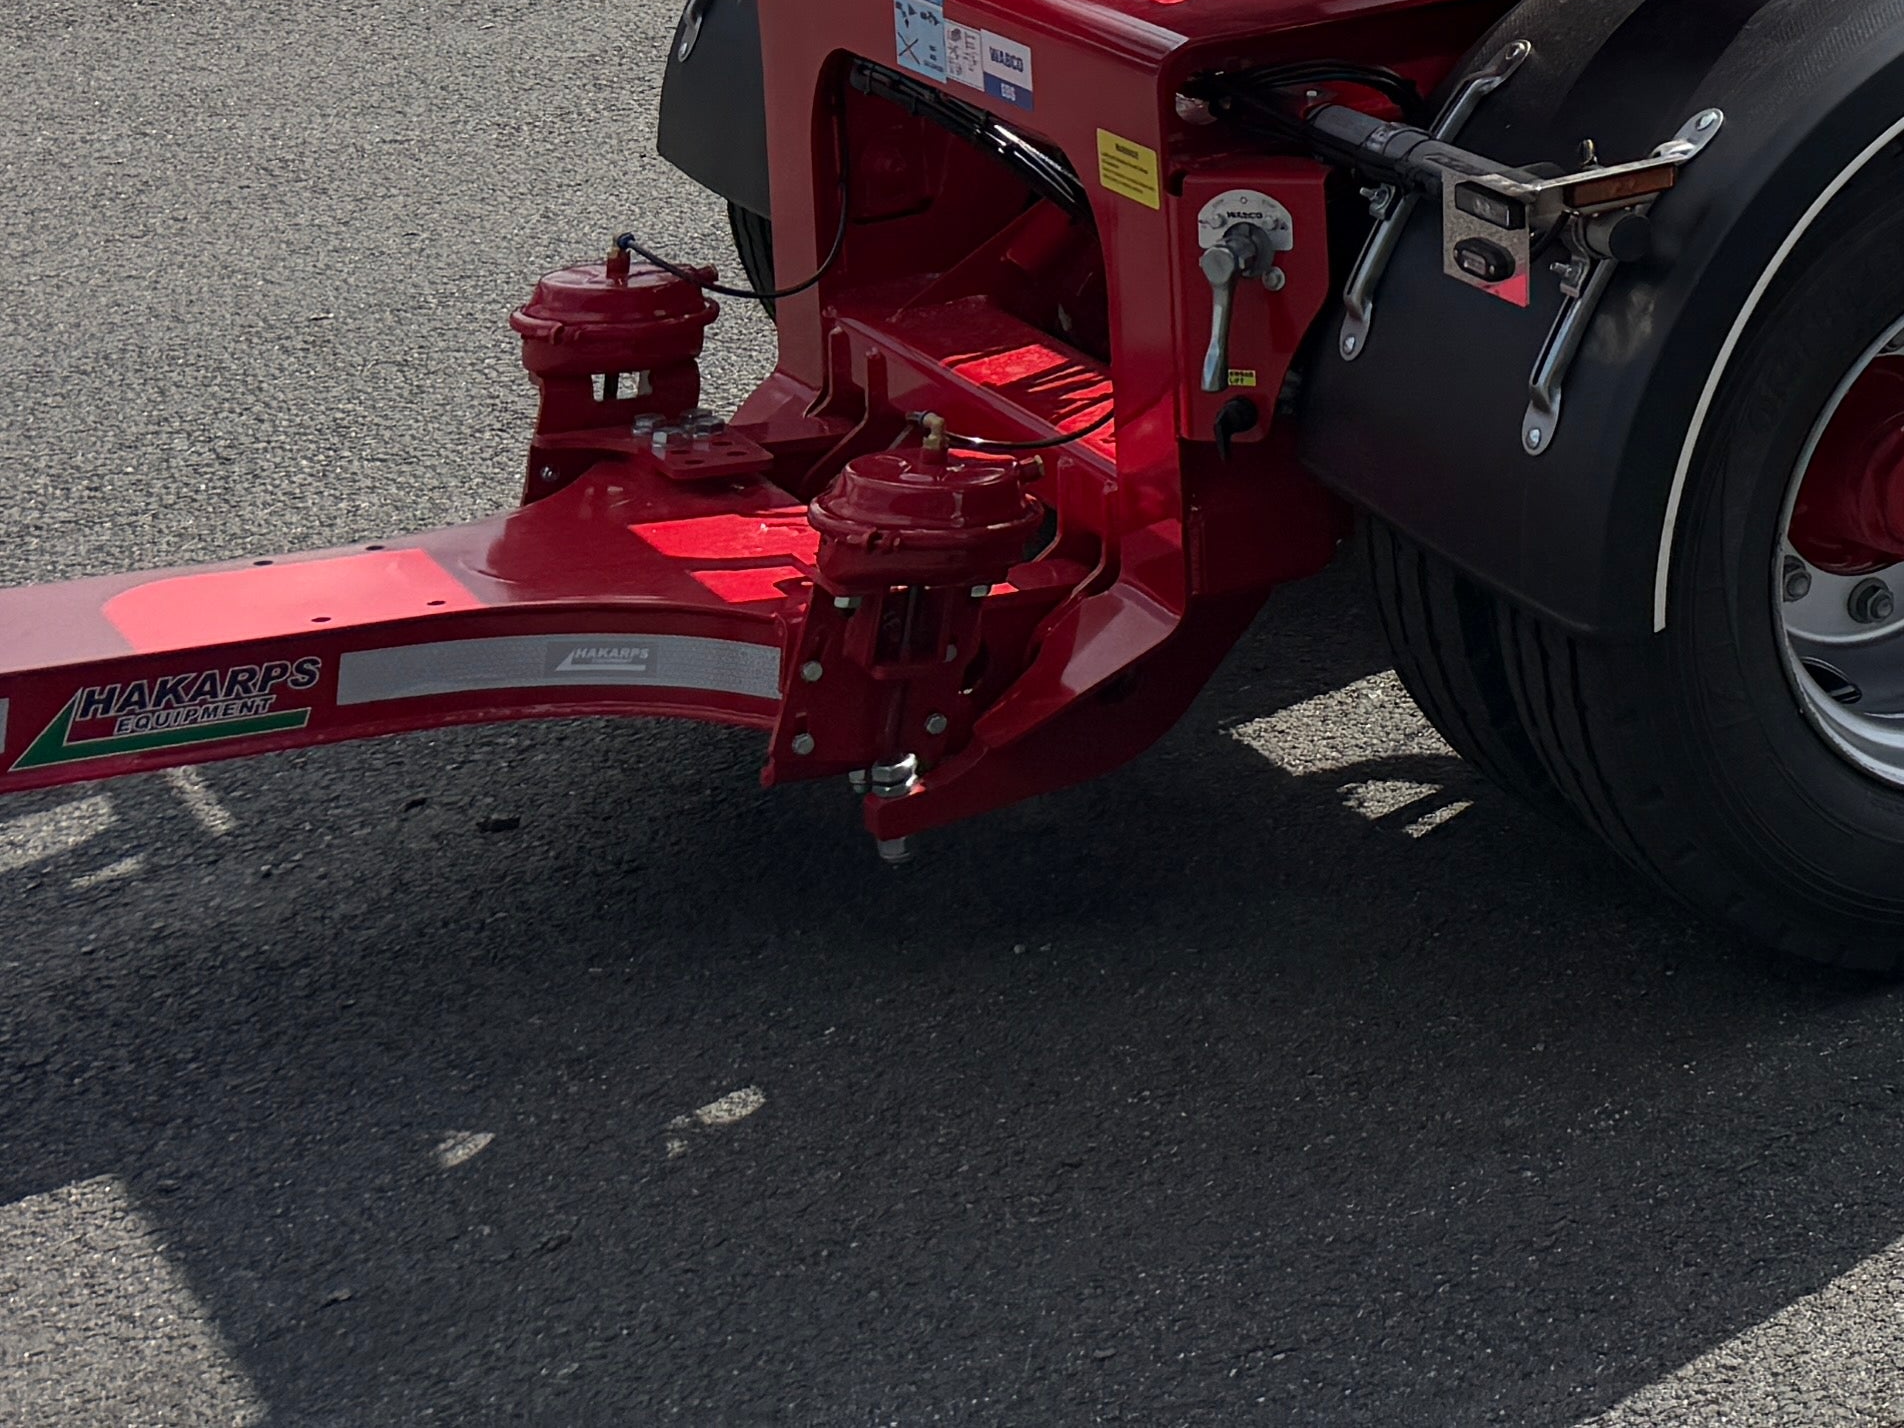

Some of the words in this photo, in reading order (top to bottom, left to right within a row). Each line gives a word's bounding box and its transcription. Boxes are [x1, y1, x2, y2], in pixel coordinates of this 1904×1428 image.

[574, 647, 649, 659] HAKARPS
[75, 656, 322, 721] HAKARPS
[113, 694, 277, 736] EQUIPMENT
